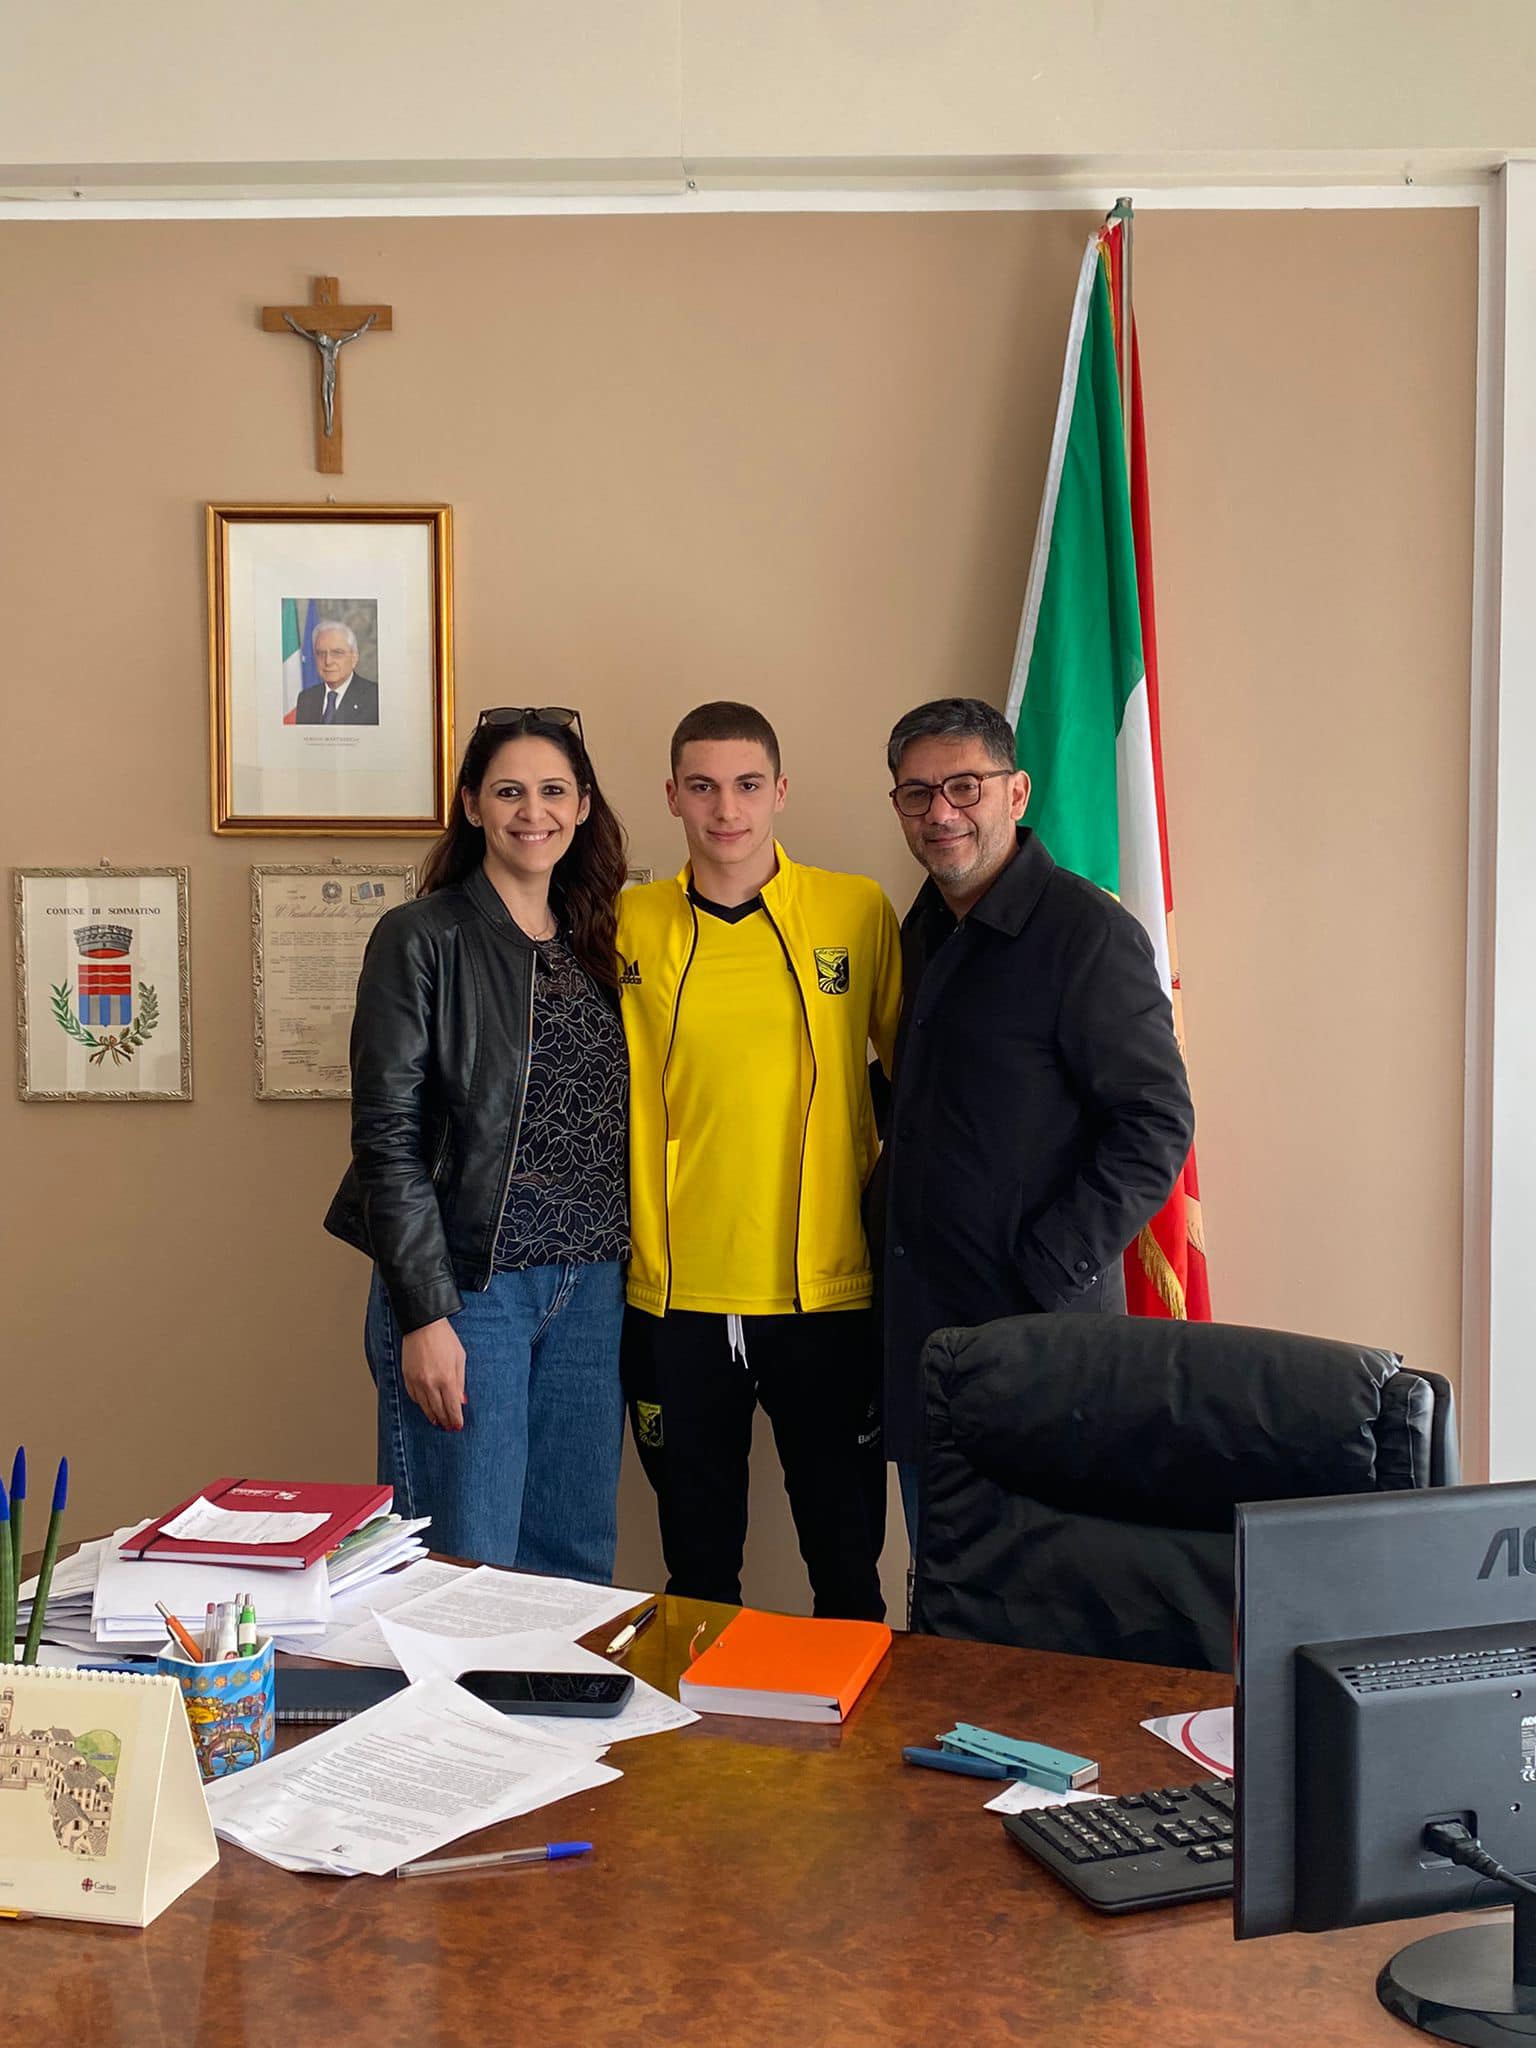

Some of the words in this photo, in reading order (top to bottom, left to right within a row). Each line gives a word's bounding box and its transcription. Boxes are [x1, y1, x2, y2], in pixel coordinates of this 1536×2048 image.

[46, 907, 84, 915] COMUNE
[92, 907, 101, 915] DI
[108, 907, 160, 915] SOMMATINO
